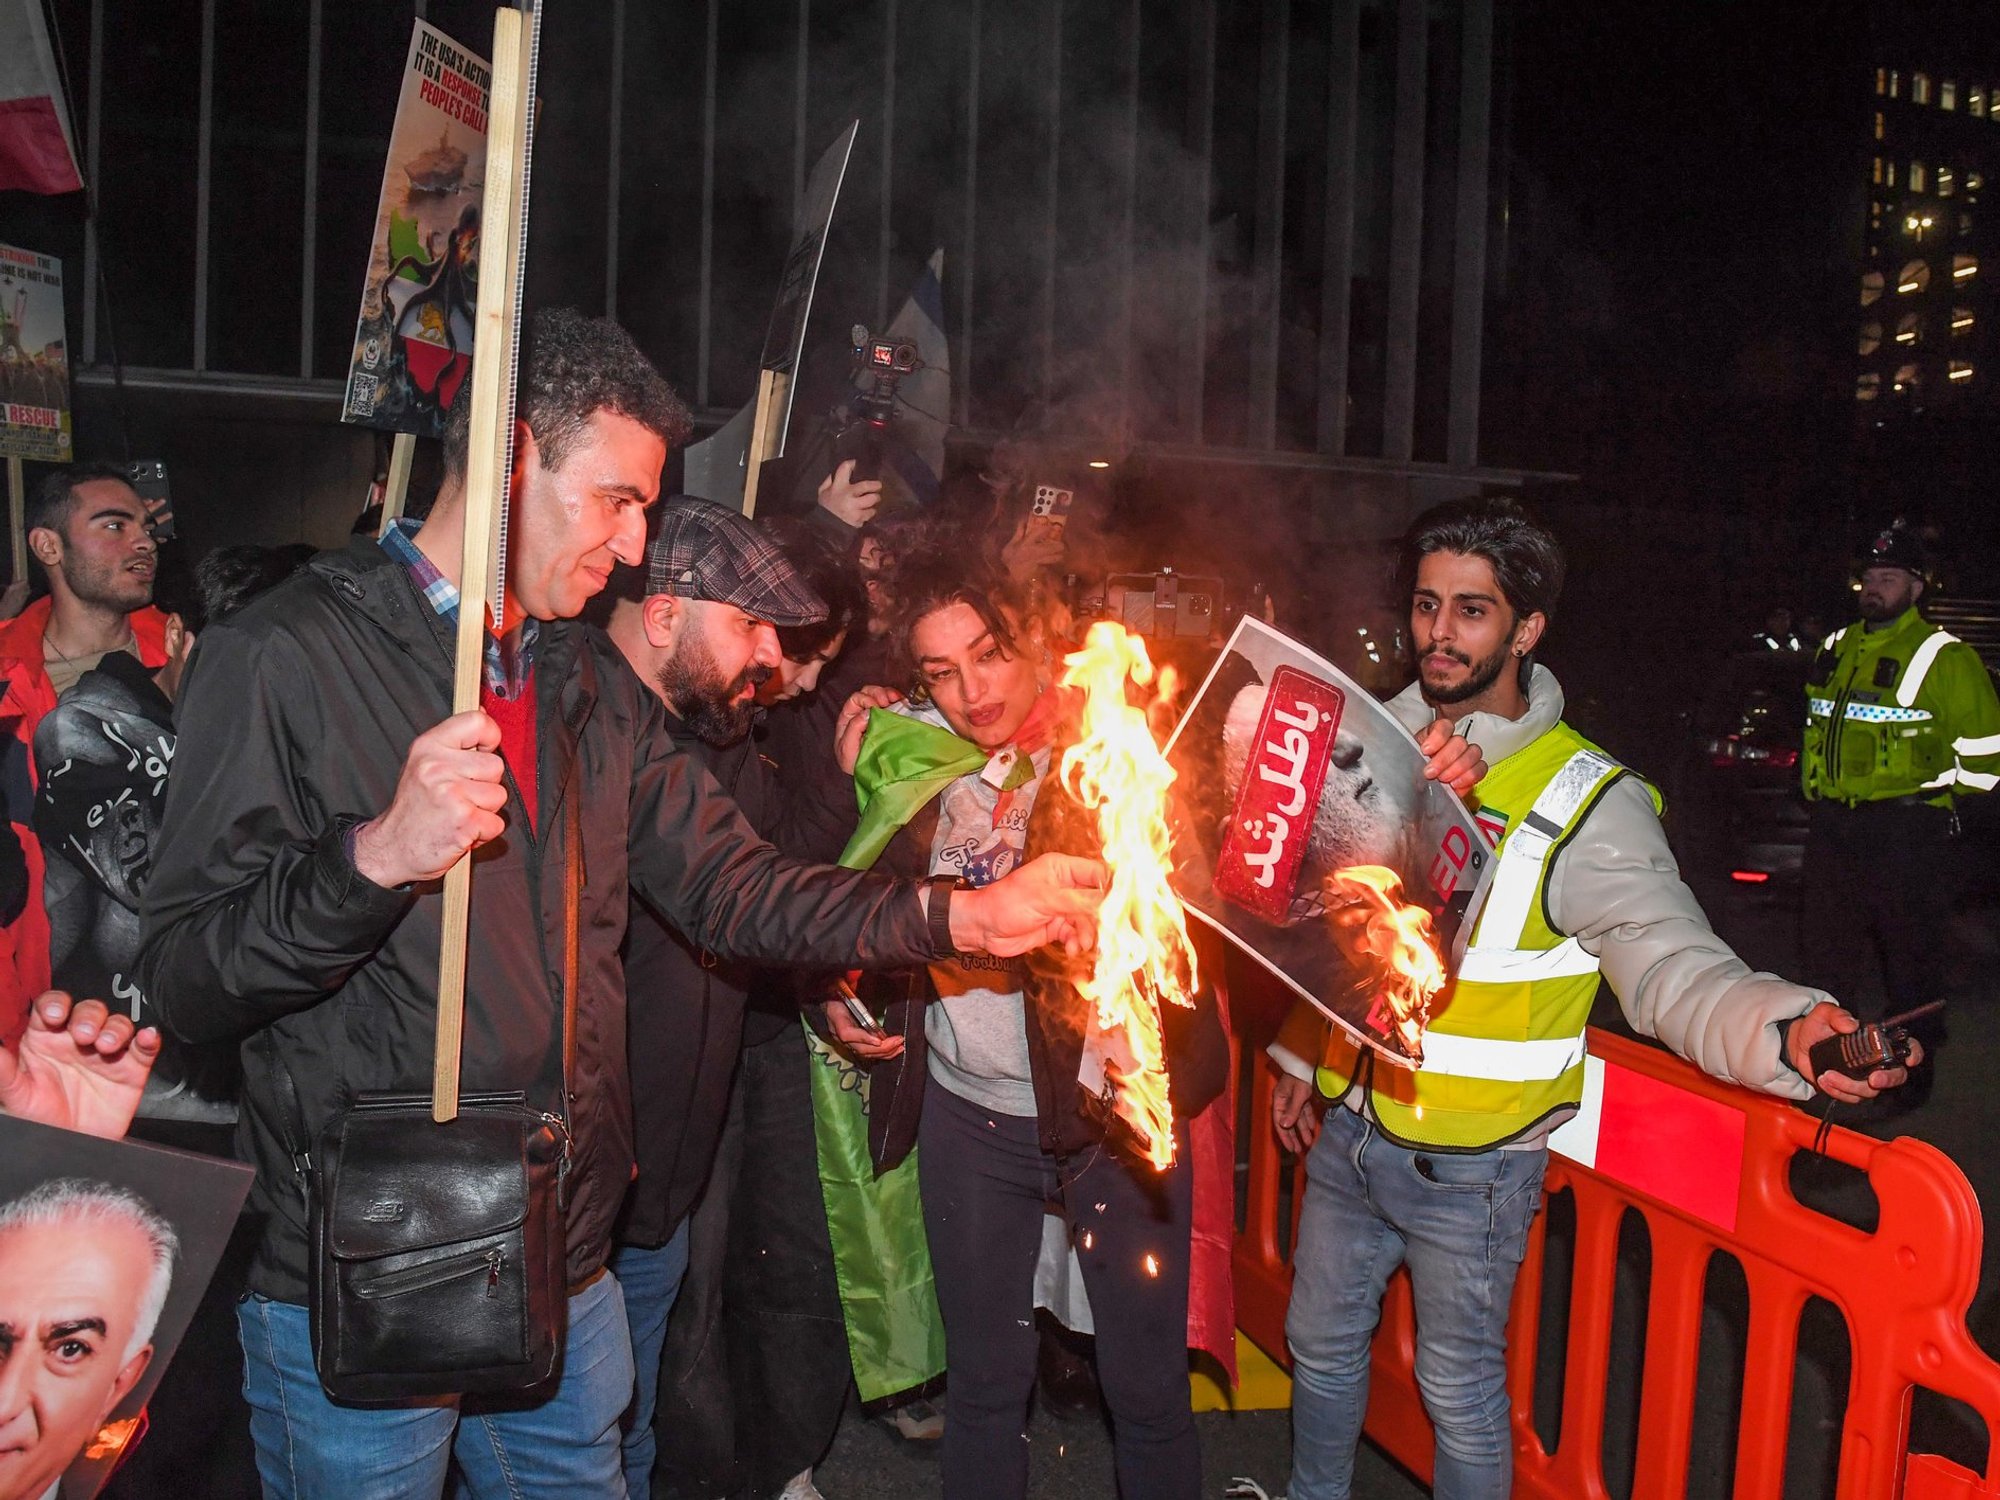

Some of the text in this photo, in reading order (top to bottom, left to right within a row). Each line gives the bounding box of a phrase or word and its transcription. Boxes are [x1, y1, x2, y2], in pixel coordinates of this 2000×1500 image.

[420, 30, 438, 58] THE
[438, 42, 464, 73] USA'S
[414, 52, 425, 72] IT
[424, 58, 435, 78] IS
[434, 65, 441, 83] A
[441, 69, 482, 107] RESPONSE
[420, 79, 463, 119] PEOPLE'S
[462, 104, 484, 132] CALL
[10, 404, 57, 427] RESCUE
[1242, 699, 1333, 890] باطل شد
